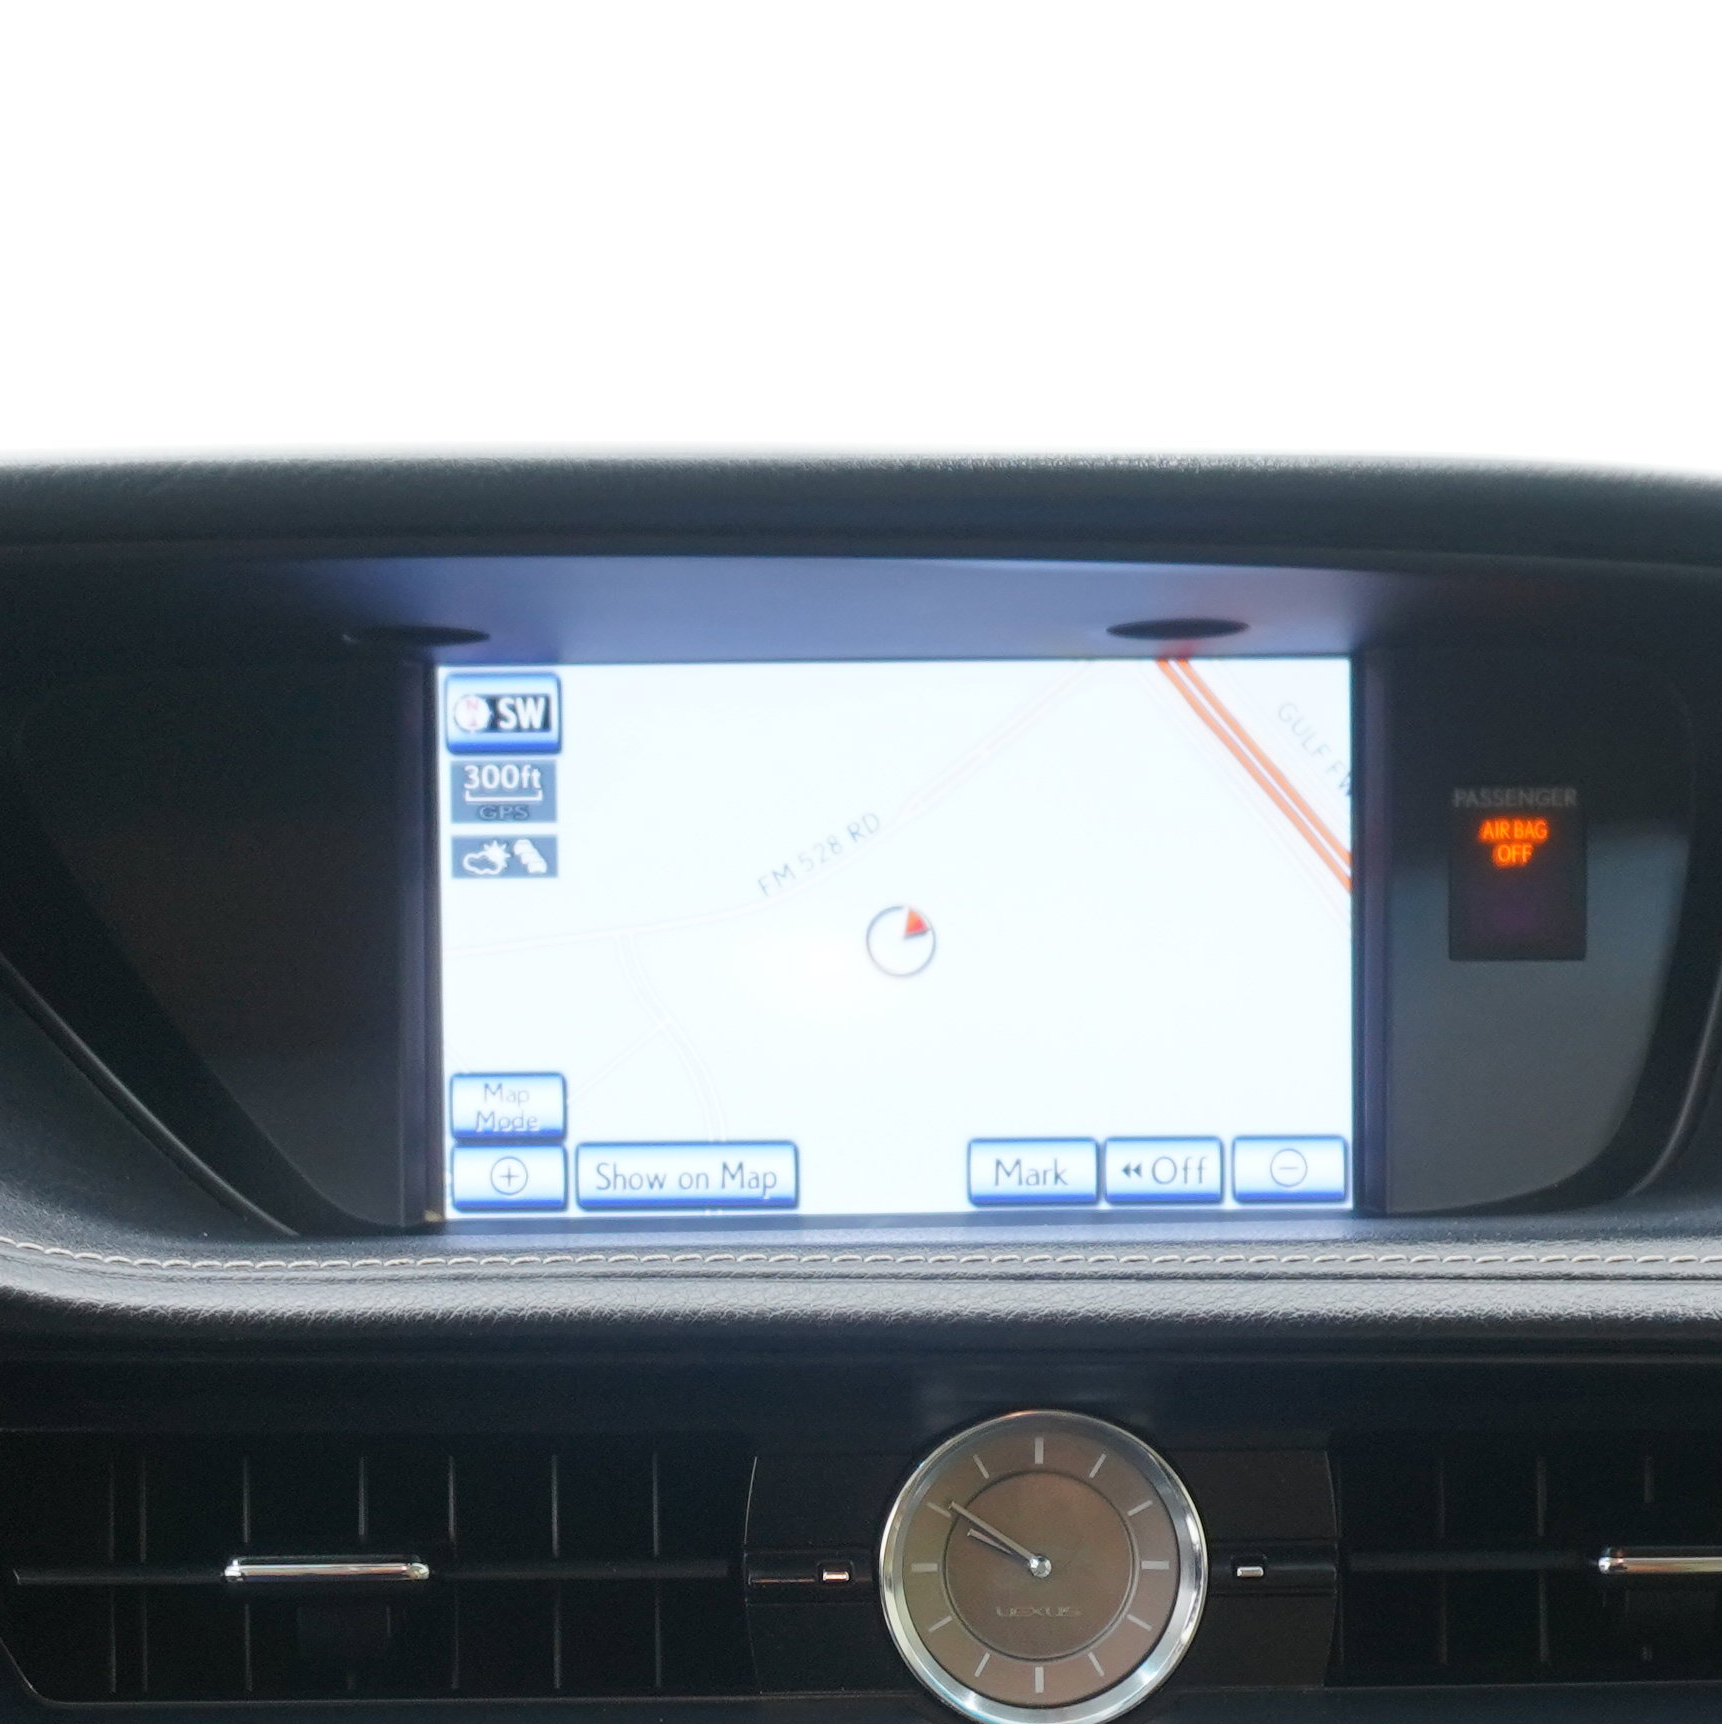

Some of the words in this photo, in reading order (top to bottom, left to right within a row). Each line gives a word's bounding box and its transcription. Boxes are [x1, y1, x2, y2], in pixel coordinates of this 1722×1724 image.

[498, 696, 547, 730] SW
[1277, 702, 1332, 760] GULF
[463, 763, 543, 791] 300ft
[1454, 788, 1578, 808] PASSENGER
[479, 804, 530, 822] GPS
[1480, 818, 1511, 841] AIR
[1513, 818, 1549, 841] BAG
[756, 862, 795, 898] FM
[798, 833, 845, 879] 528
[846, 811, 883, 845] RD
[1493, 843, 1534, 867] OFF
[483, 1082, 531, 1106] Map
[476, 1110, 541, 1134] Mode
[595, 1162, 667, 1192] Show
[678, 1171, 710, 1191] on
[720, 1162, 779, 1200] Map
[994, 1158, 1069, 1187] Mark
[1150, 1155, 1209, 1186] Off
[996, 1605, 1082, 1619] LEXUS
